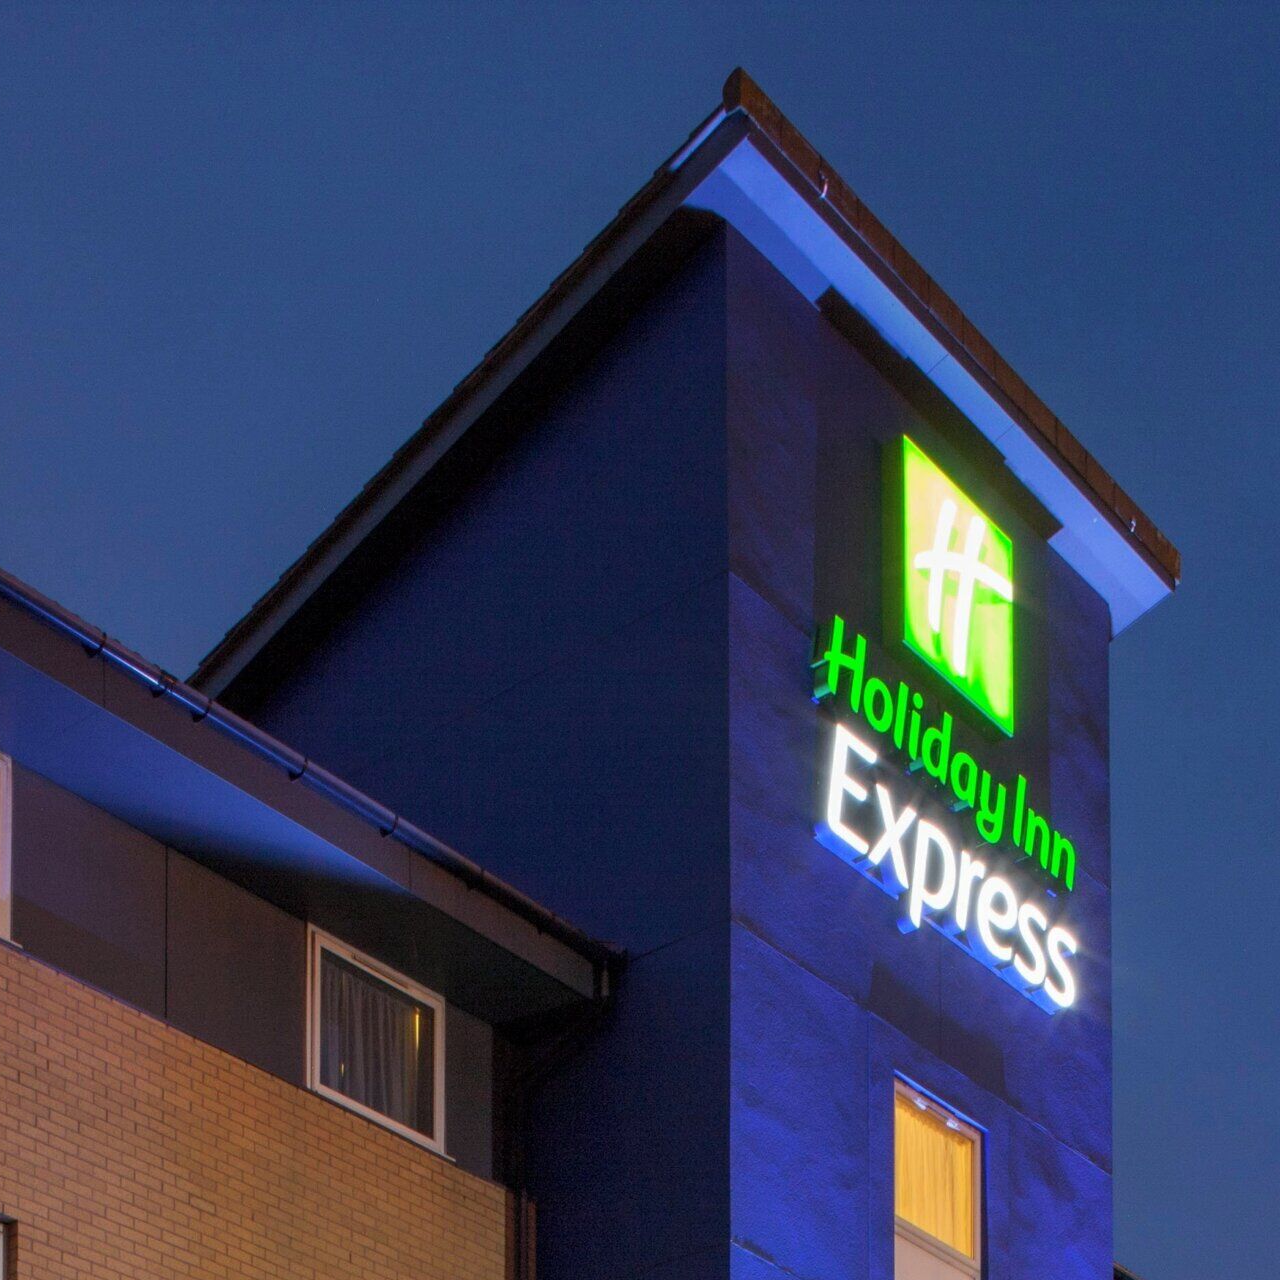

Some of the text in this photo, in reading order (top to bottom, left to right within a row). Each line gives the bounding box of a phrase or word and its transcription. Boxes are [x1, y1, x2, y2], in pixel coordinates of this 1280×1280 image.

[823, 614, 1077, 892] Holiday Inn
[826, 723, 1078, 1008] Express
